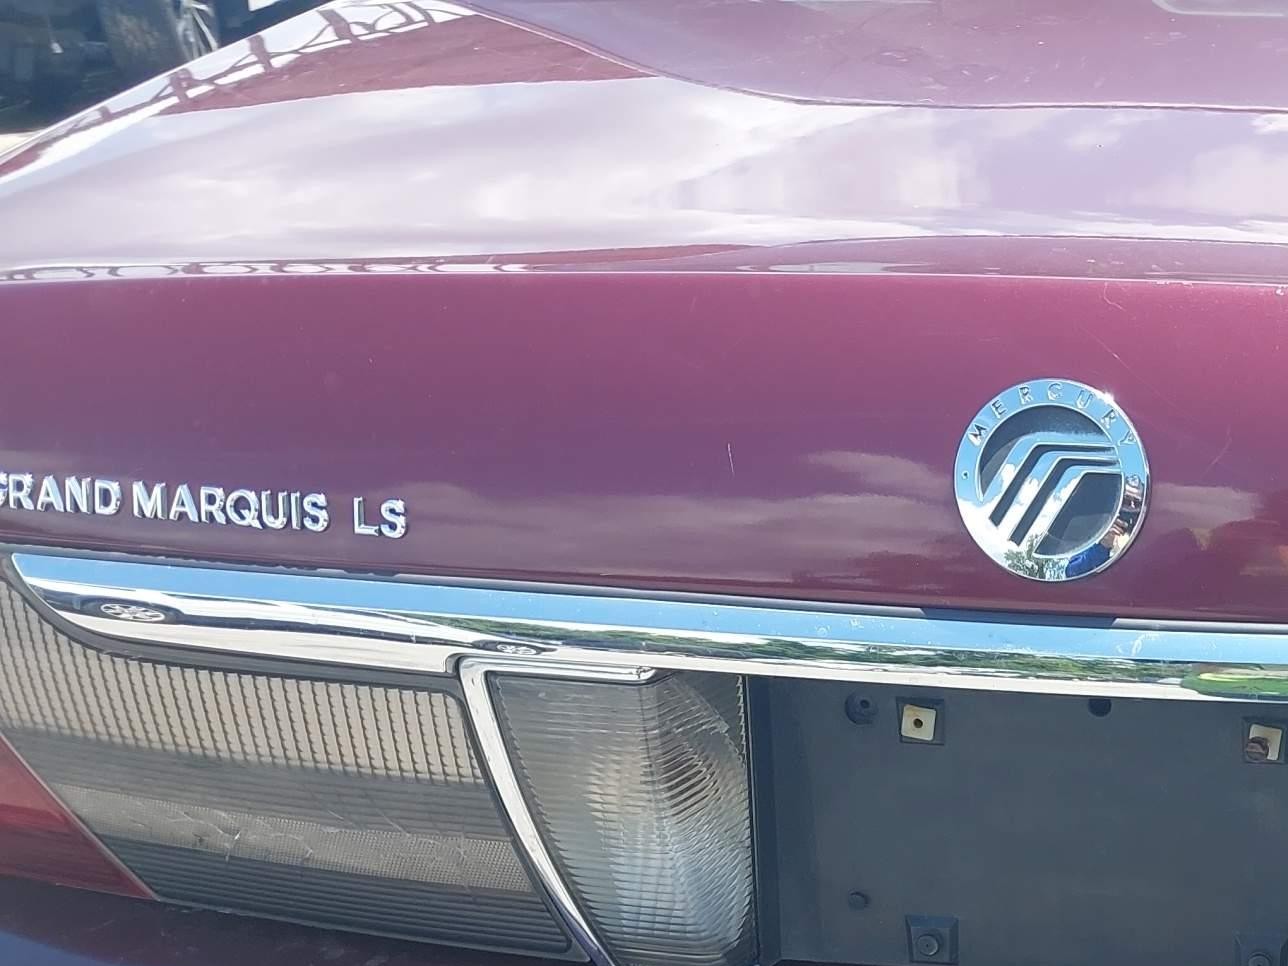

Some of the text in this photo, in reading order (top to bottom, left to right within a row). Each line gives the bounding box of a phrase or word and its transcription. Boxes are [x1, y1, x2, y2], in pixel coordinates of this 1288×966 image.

[967, 382, 1137, 447] MERCURY
[132, 480, 330, 532] MARQUIS
[352, 496, 409, 539] LS
